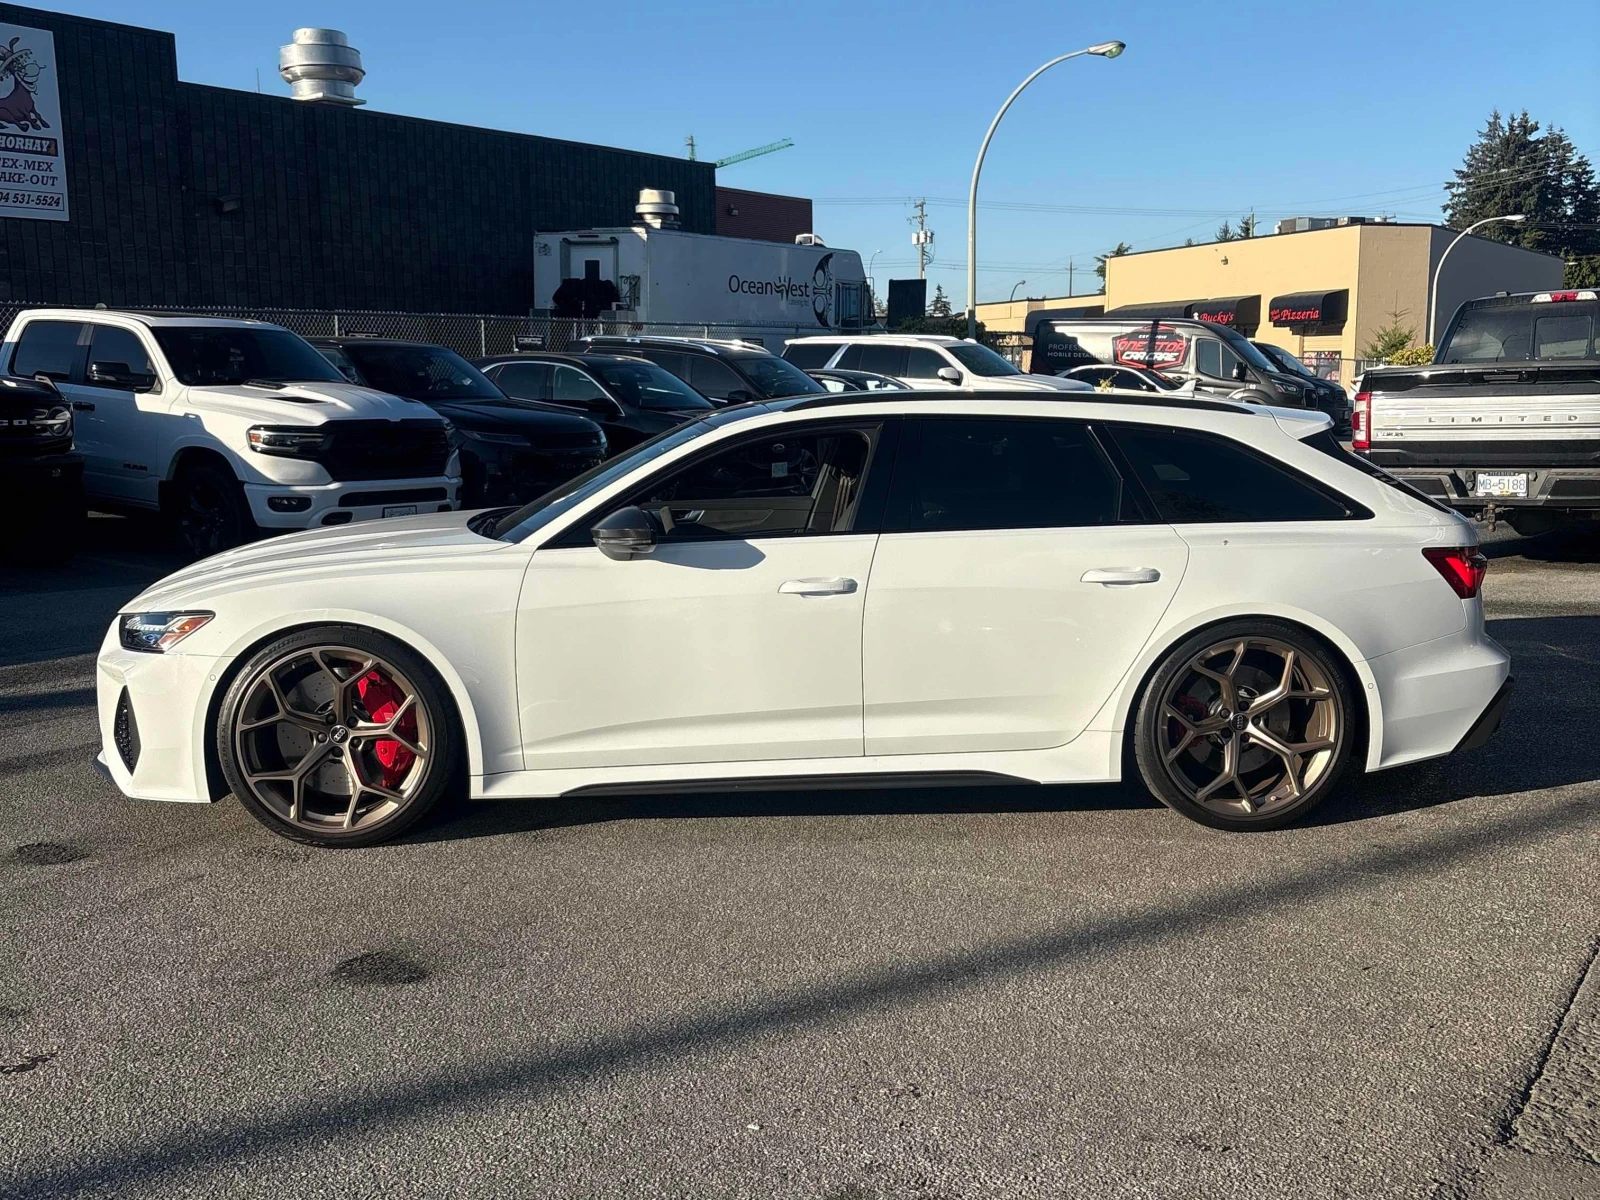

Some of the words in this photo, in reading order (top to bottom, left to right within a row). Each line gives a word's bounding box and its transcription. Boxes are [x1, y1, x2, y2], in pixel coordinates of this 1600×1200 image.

[0, 157, 54, 172] EX-MEX
[12, 193, 61, 207] 531-5524
[1200, 311, 1235, 325] Bucky's
[1280, 307, 1320, 321] Pizzeria
[1116, 340, 1148, 351] ONE
[1122, 351, 1146, 361] CAR
[1145, 351, 1180, 361] CARE
[1428, 415, 1578, 423] LIMITED
[1498, 479, 1525, 490] 5188
